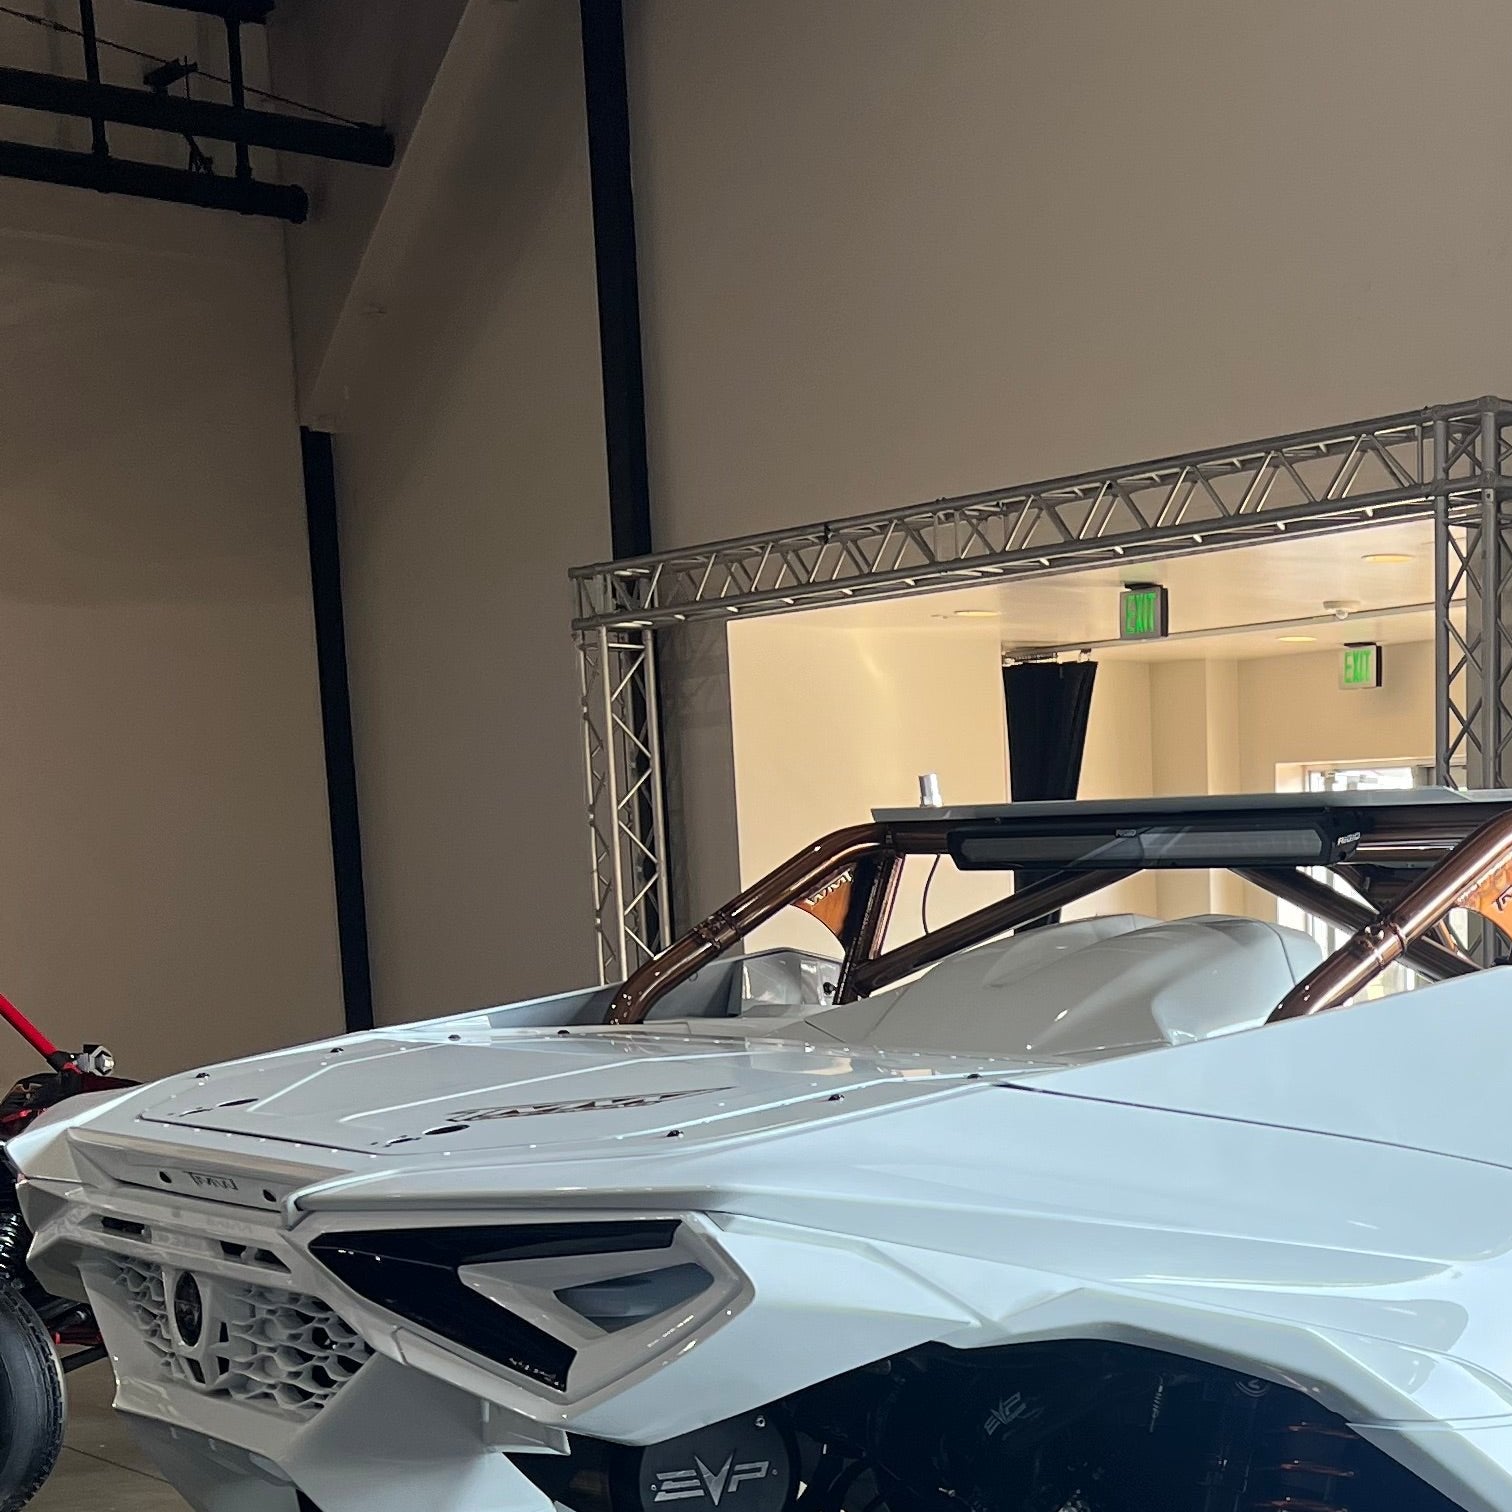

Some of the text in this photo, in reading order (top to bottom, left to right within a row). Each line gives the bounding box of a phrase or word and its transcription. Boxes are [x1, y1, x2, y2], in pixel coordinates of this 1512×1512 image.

[1125, 591, 1157, 635] EXIT
[1344, 649, 1373, 684] EXIT
[654, 1451, 770, 1506] EVP
